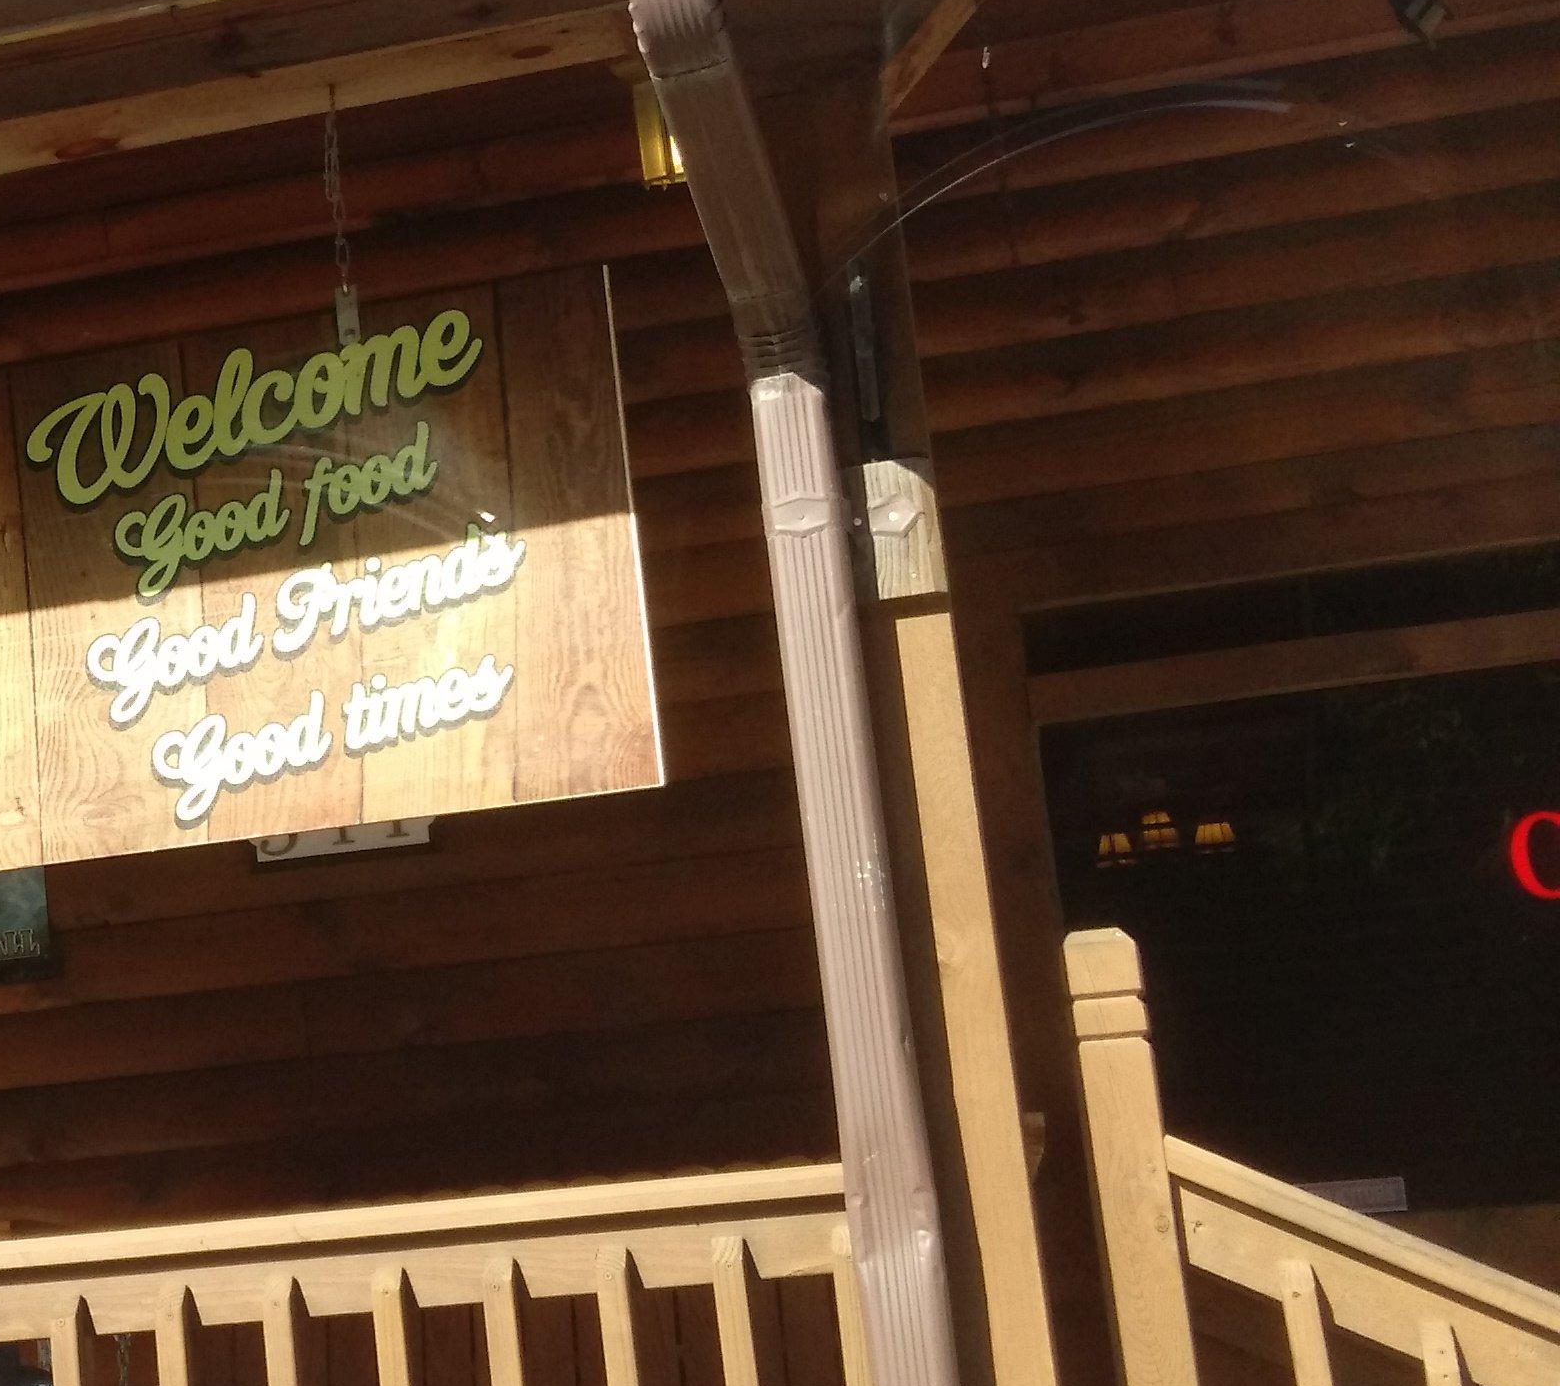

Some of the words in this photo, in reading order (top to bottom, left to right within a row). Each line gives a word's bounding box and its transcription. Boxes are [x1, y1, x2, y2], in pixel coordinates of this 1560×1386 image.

[27, 310, 482, 505] Welcome
[115, 470, 289, 597] Good
[298, 421, 437, 545] food
[87, 593, 264, 724] Good
[273, 522, 526, 657] Friends
[152, 691, 333, 823] Good
[342, 655, 513, 753] times
